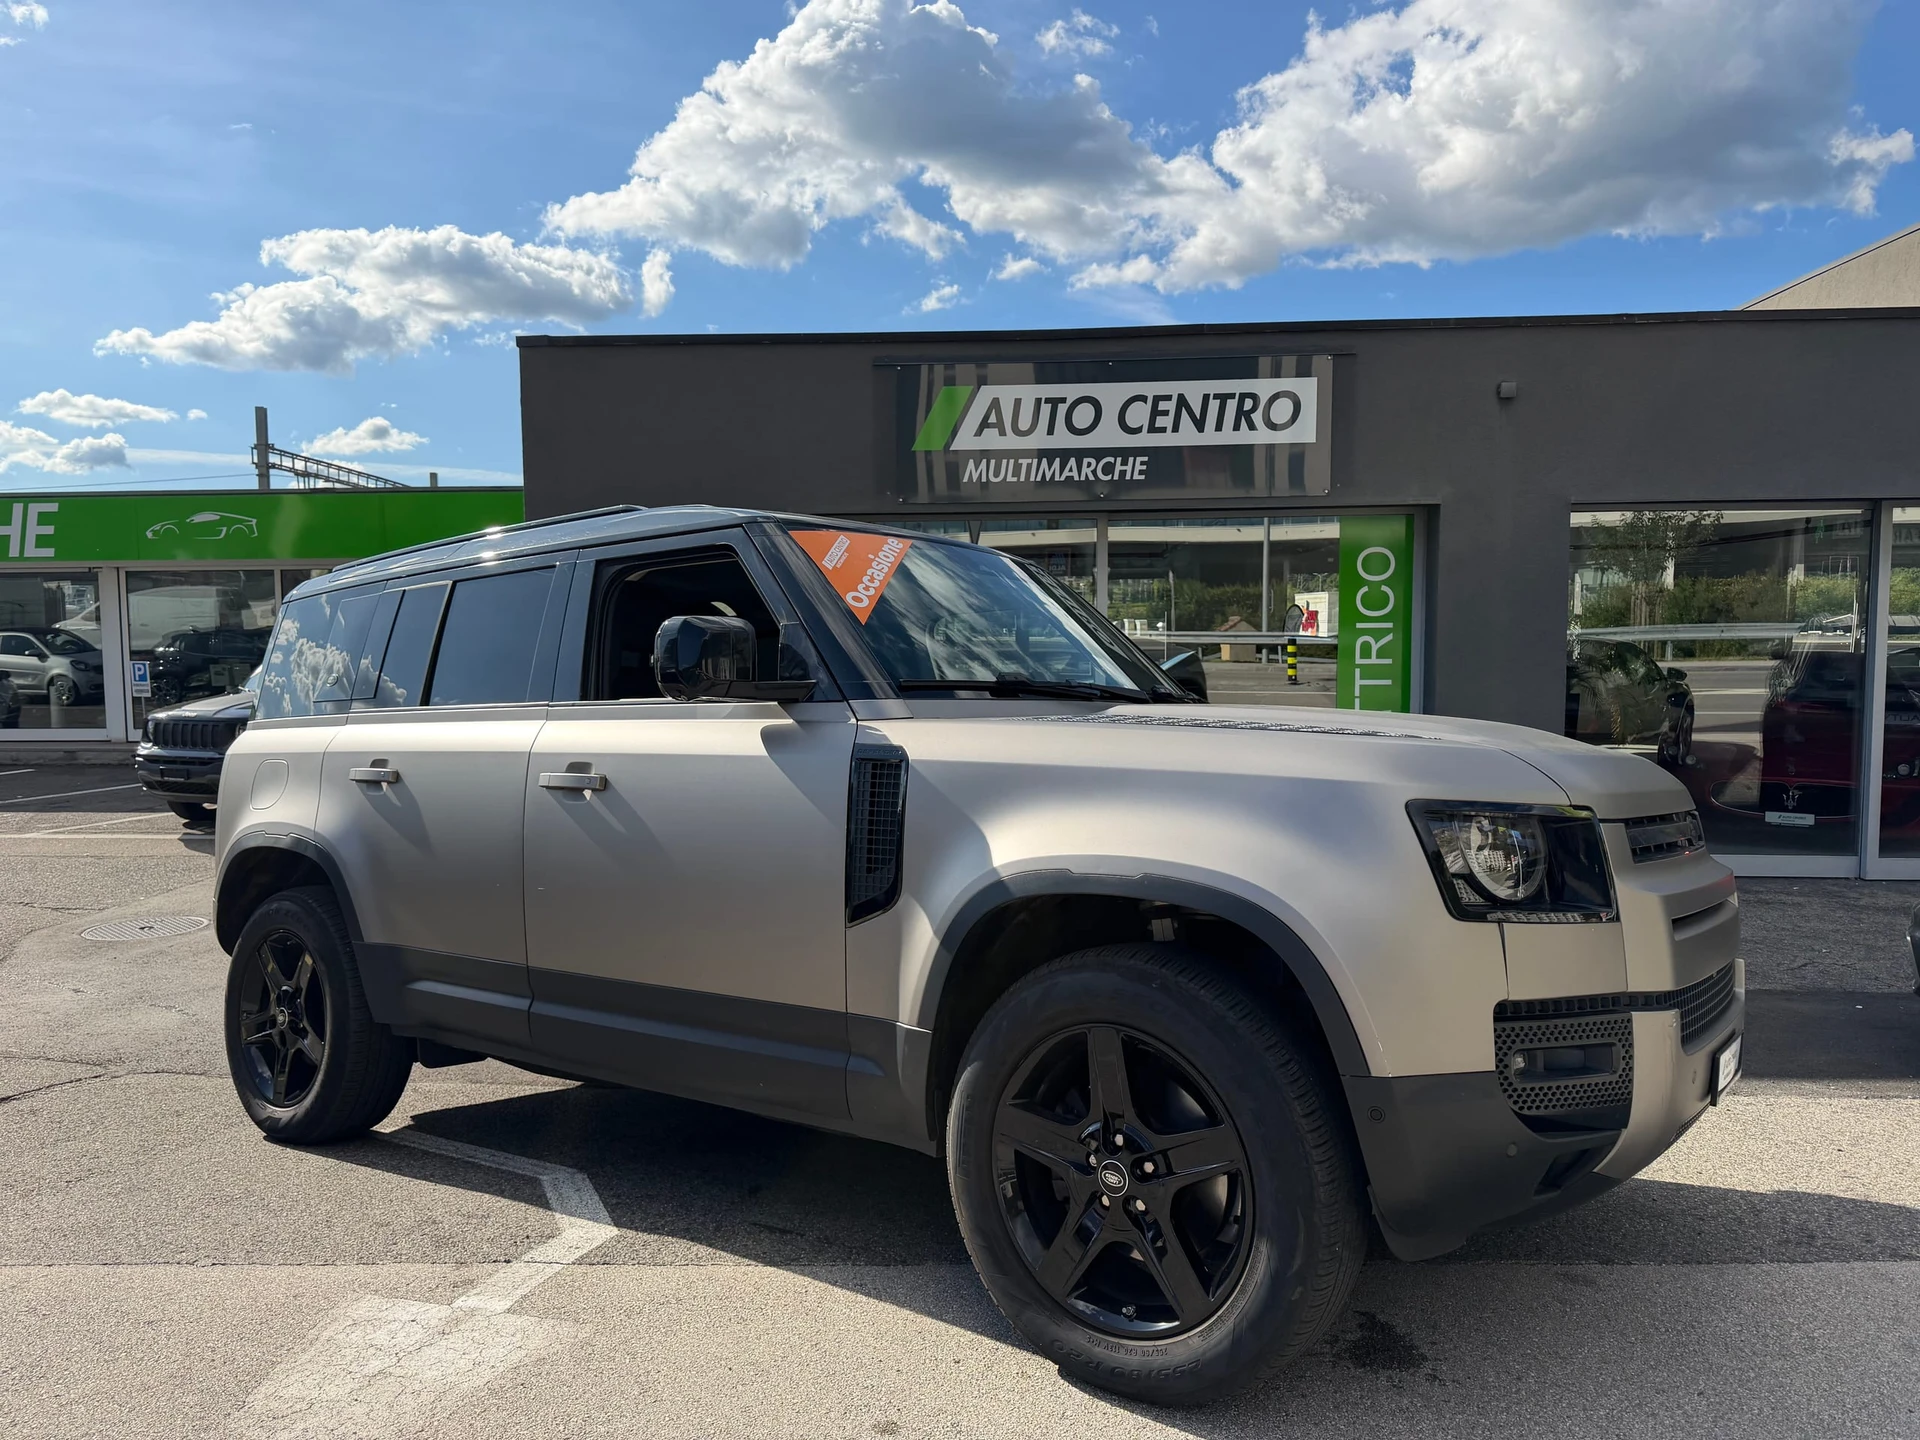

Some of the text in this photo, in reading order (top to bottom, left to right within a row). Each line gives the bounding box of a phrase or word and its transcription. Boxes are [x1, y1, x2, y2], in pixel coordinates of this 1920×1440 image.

[973, 389, 1302, 438] AUTO CENTRO
[962, 456, 1149, 483] MULTIMARCHE
[845, 538, 904, 608] Occasione
[134, 664, 144, 680] P
